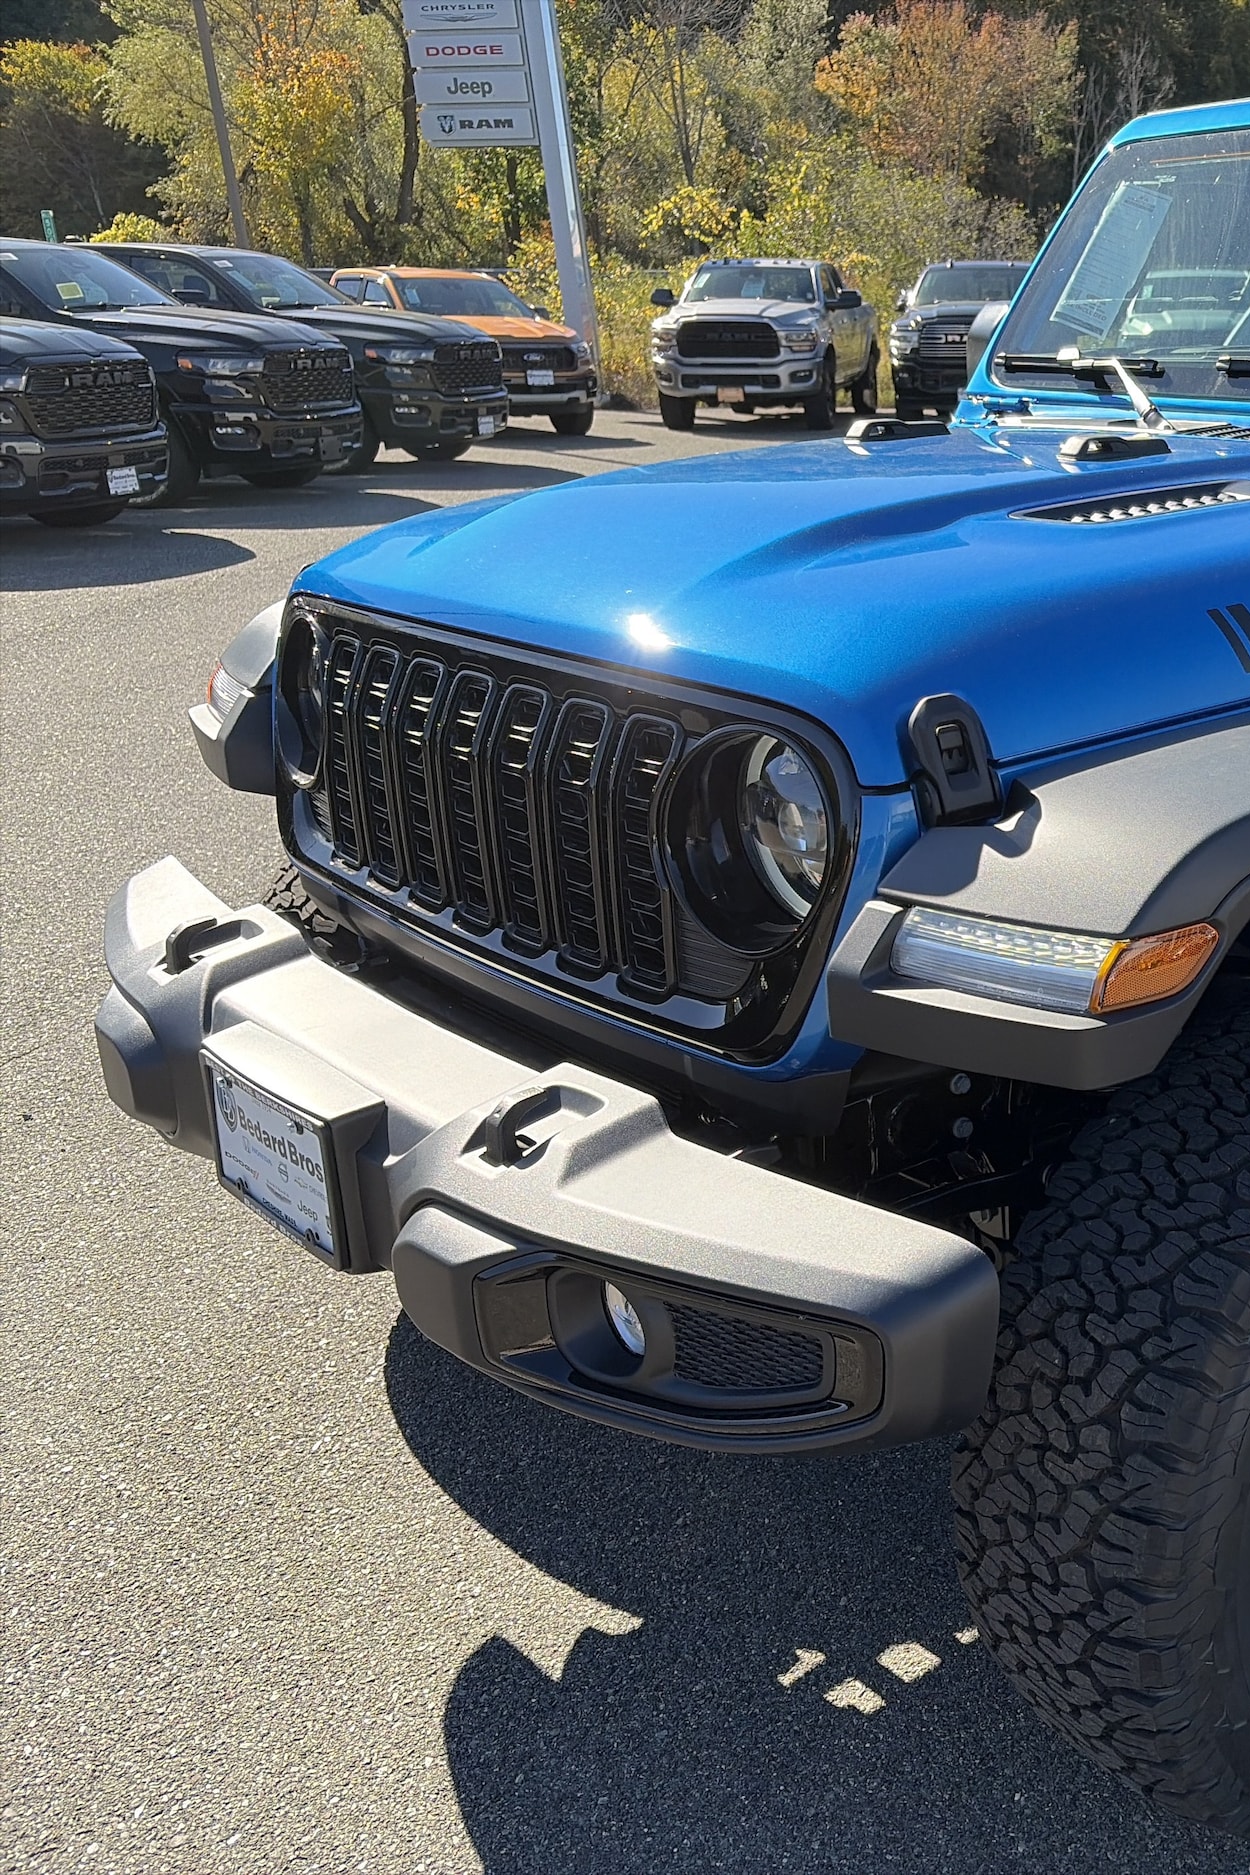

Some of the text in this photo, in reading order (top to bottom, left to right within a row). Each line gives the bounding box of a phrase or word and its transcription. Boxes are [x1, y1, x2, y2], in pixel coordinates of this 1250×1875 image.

[420, 3, 495, 12] CHRYSLER
[425, 44, 504, 57] DODGE
[446, 77, 493, 97] Jeep
[458, 118, 514, 129] RAM
[296, 357, 339, 370] RAM
[71, 371, 137, 387] RAM
[237, 1104, 324, 1184] Bedard Bros
[297, 1199, 318, 1223] Jeep
